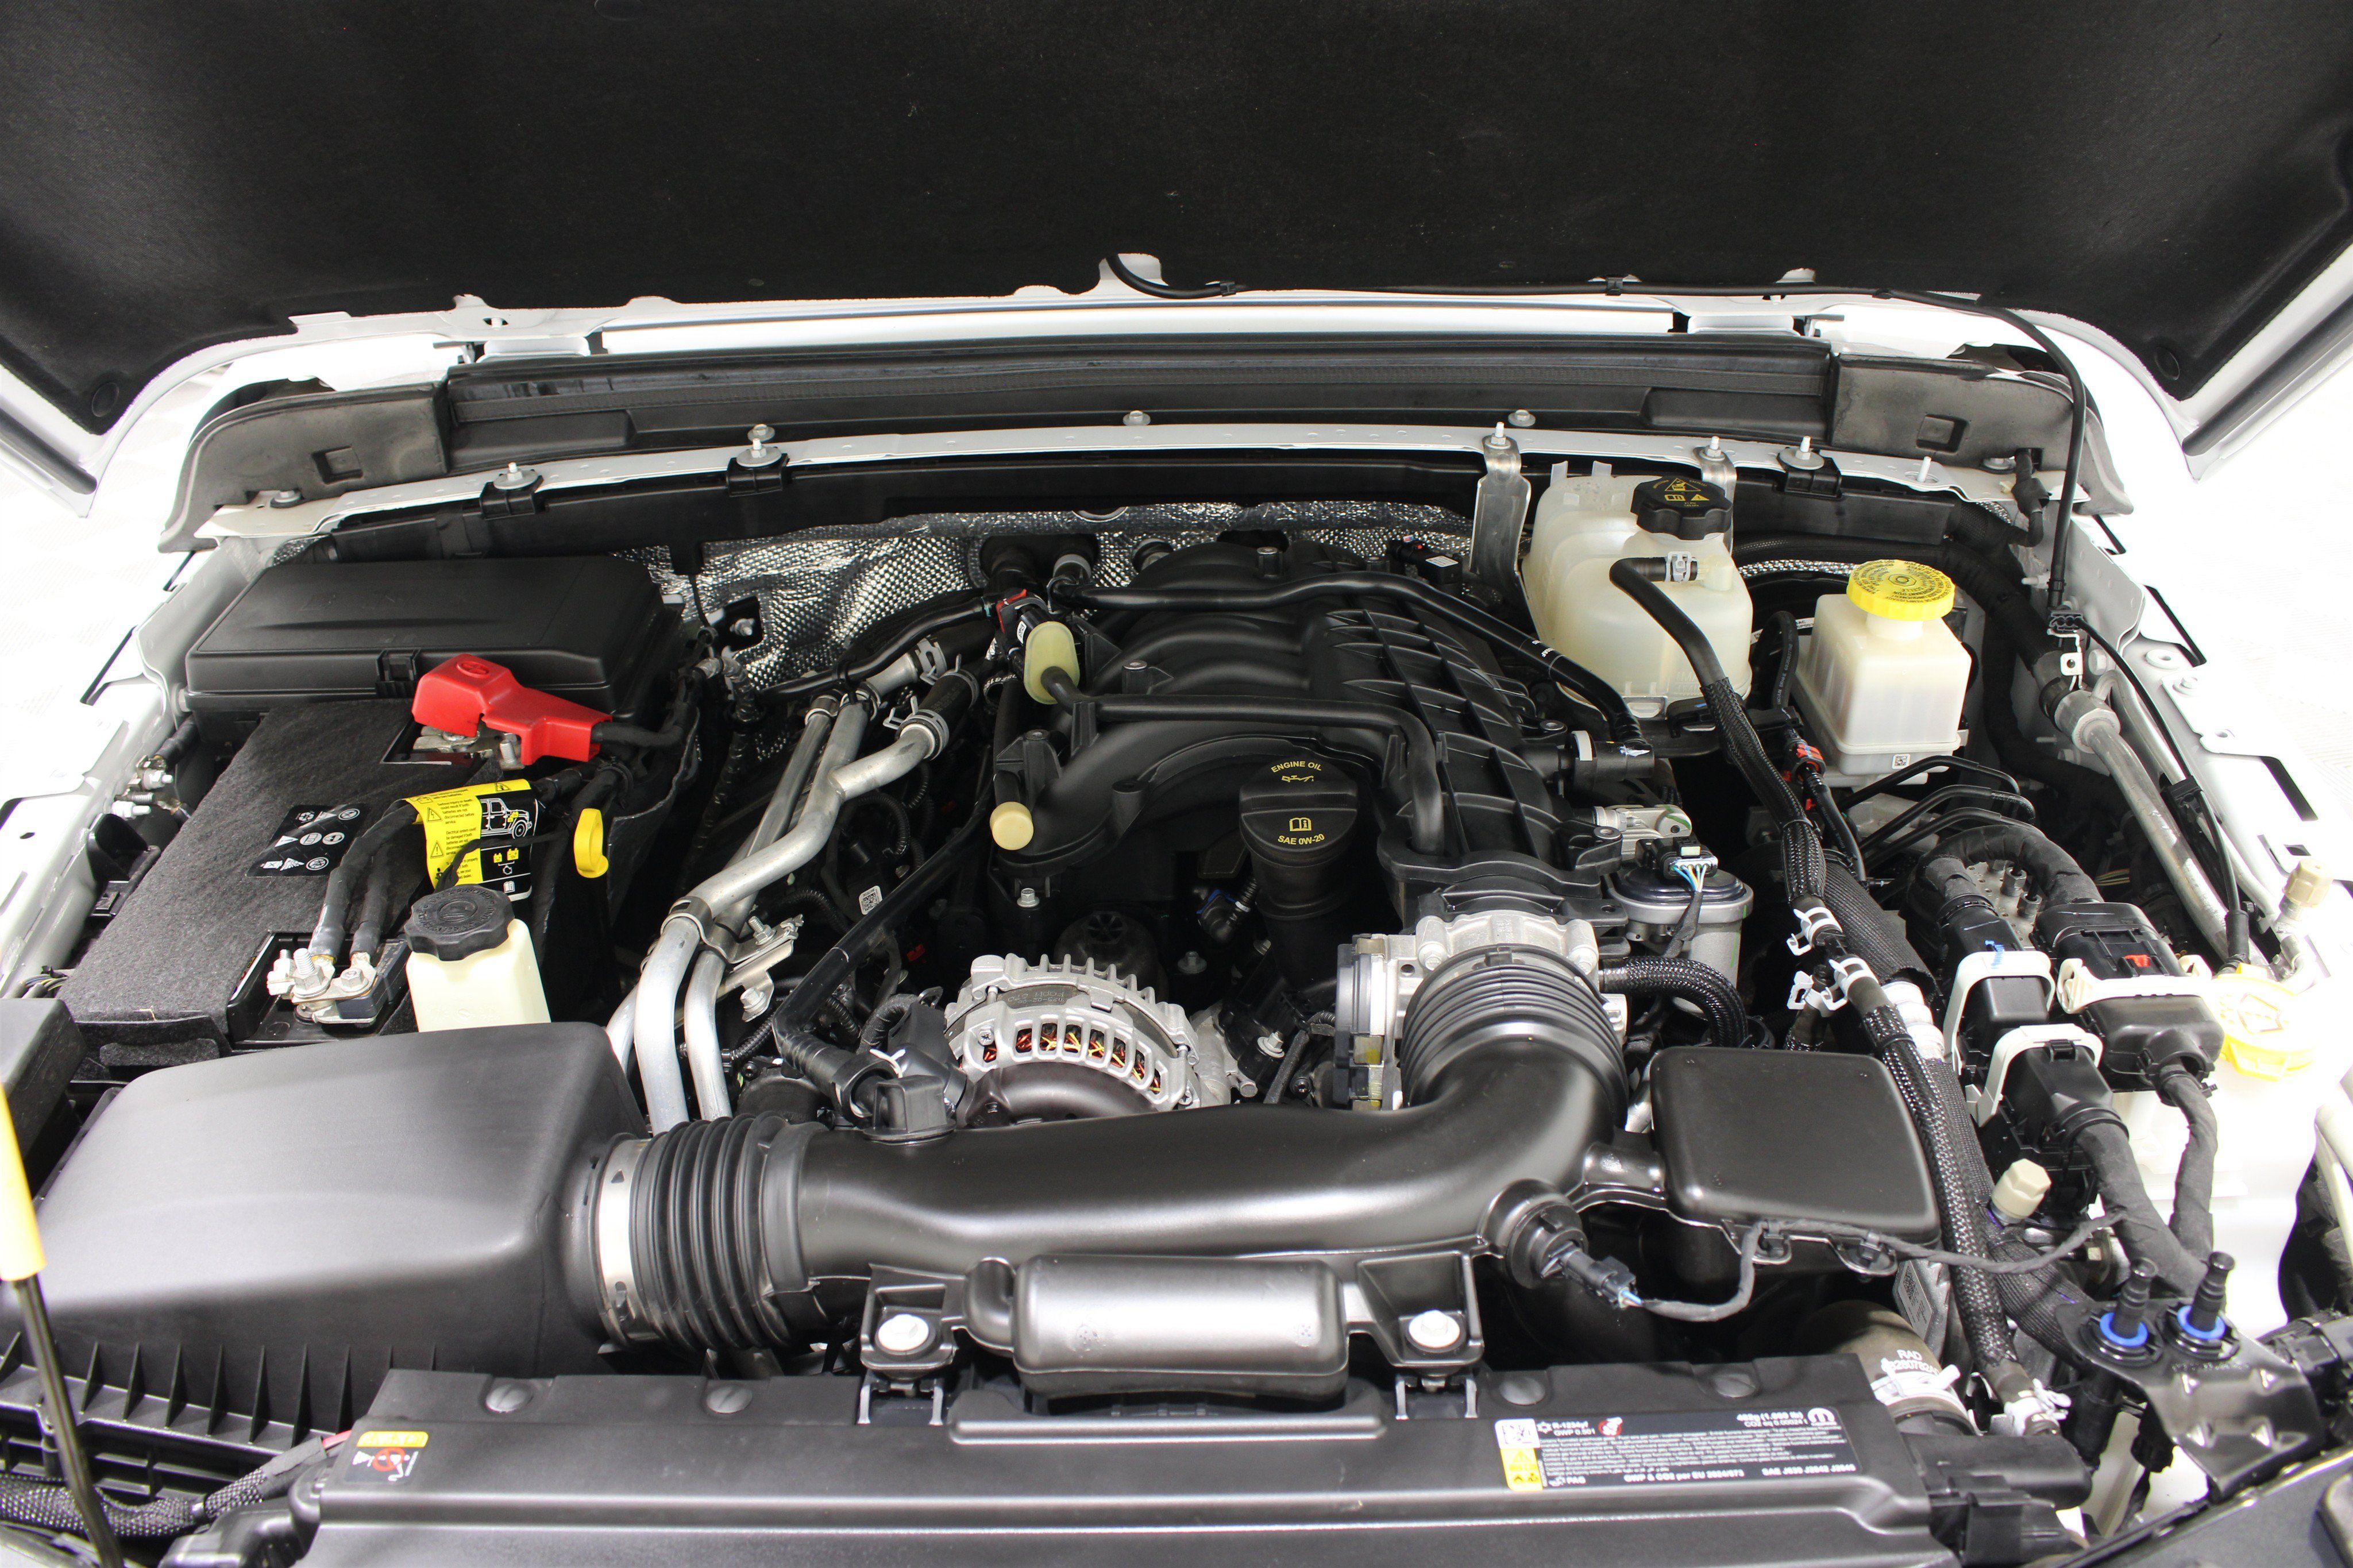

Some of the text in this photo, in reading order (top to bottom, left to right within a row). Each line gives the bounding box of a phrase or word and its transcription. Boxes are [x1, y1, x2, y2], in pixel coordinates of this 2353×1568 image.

[1271, 761, 1322, 773] ENGINE OIL
[1277, 833, 1325, 845] SAE 0W-20
[1896, 1349, 1922, 1361] RAD
[1553, 1428, 1574, 1436] GWP
[1623, 1473, 1646, 1482] GWP
[1655, 1472, 1675, 1481] CO2
[1691, 1471, 1706, 1479] EU
[1761, 1467, 1781, 1476] SAE
[1566, 1476, 1587, 1485] PAG
